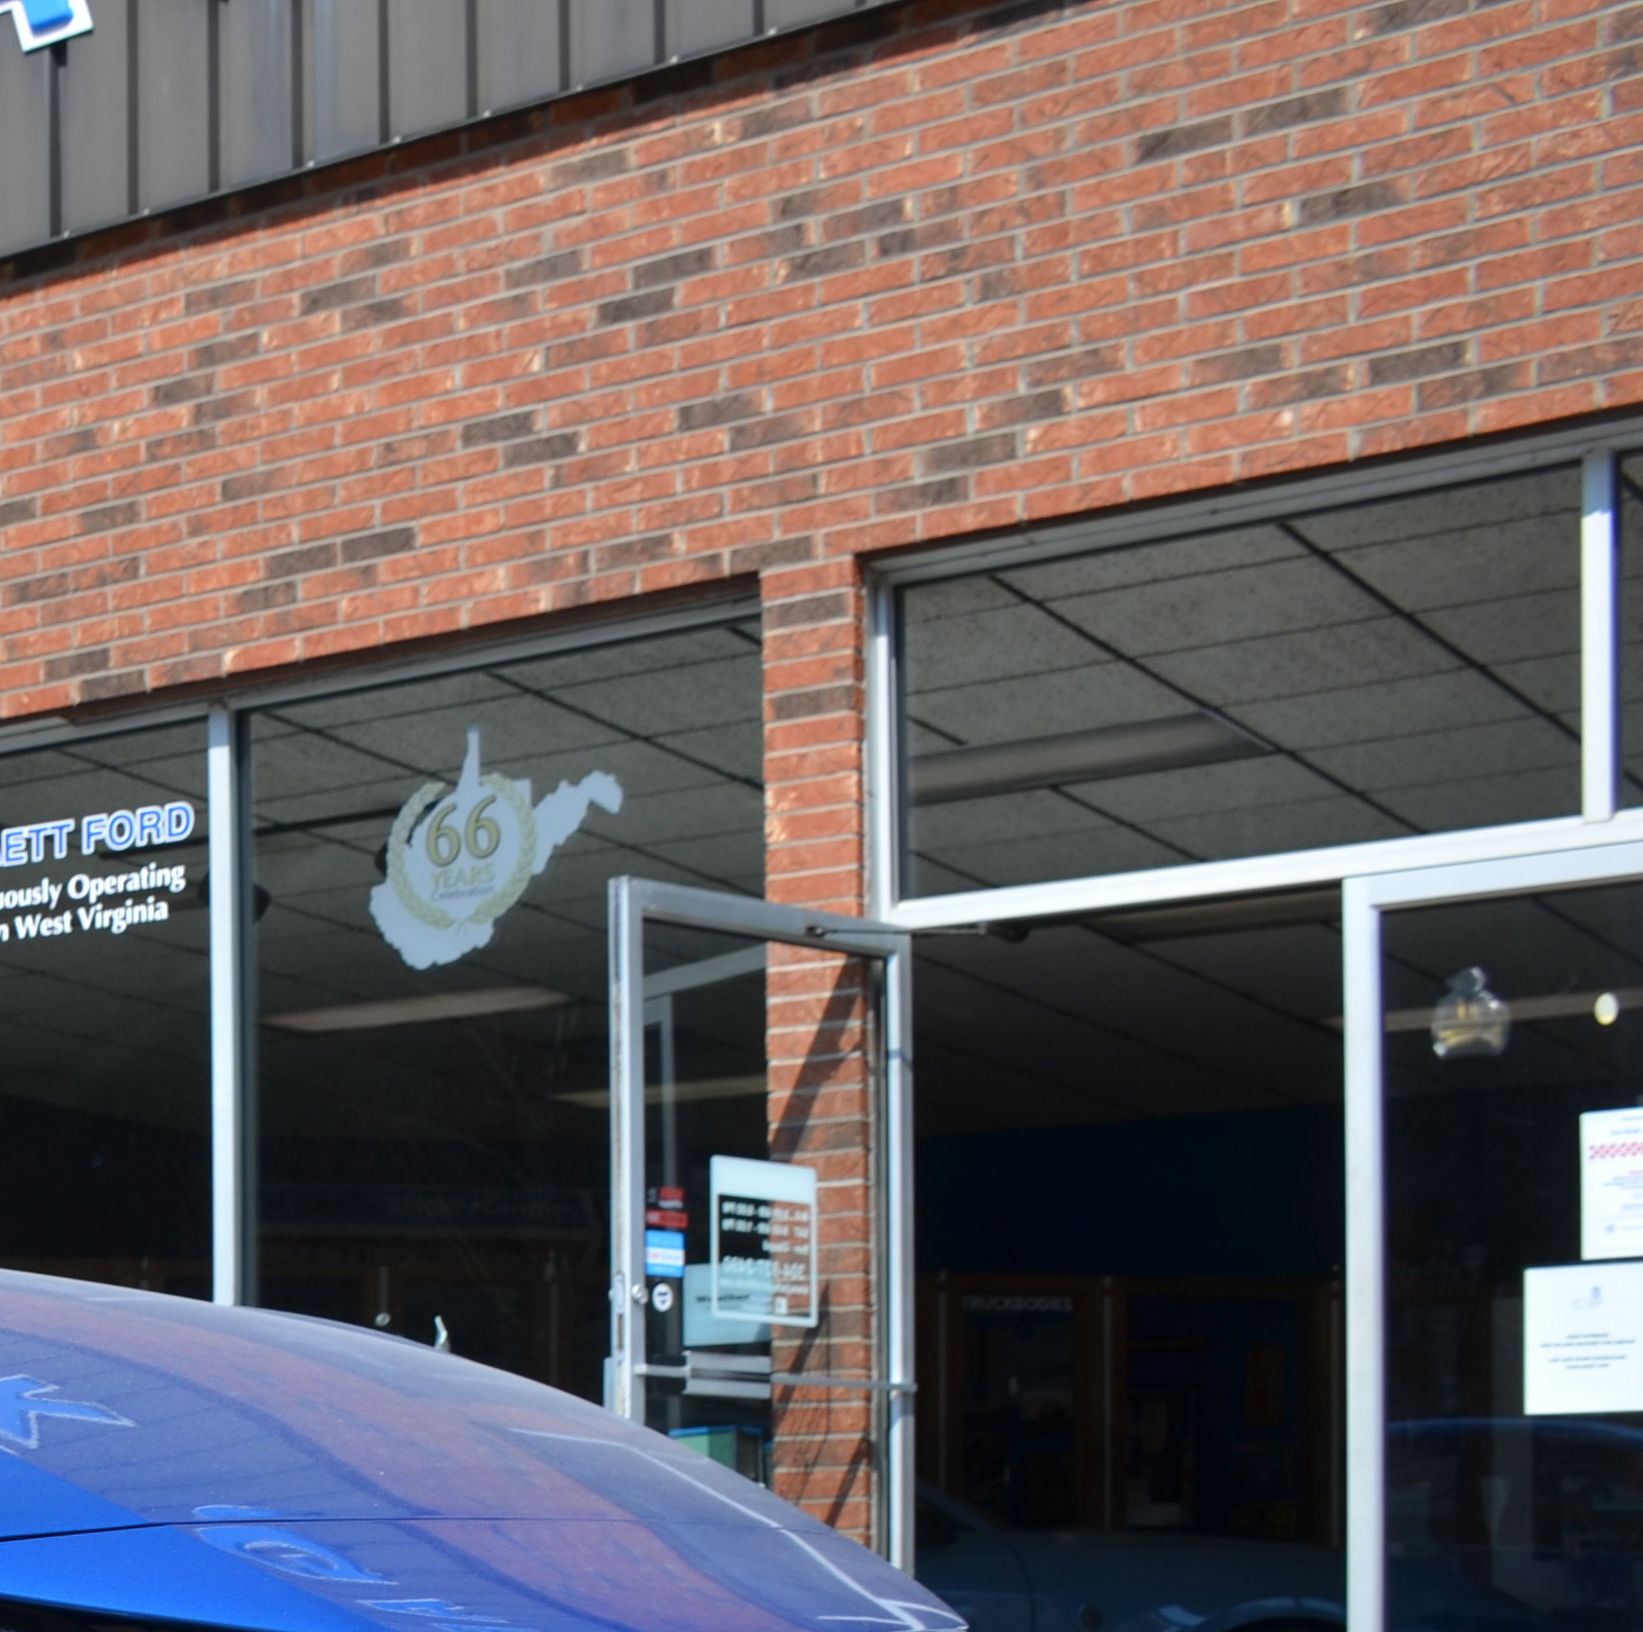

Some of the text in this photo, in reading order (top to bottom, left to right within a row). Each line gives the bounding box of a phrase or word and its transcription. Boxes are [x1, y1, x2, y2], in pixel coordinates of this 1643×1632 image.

[81, 801, 195, 855] FORD
[425, 795, 501, 868] 66
[67, 862, 186, 904] Operating
[430, 863, 496, 891] YEARS
[14, 910, 73, 940] West
[77, 895, 169, 934] Virginia
